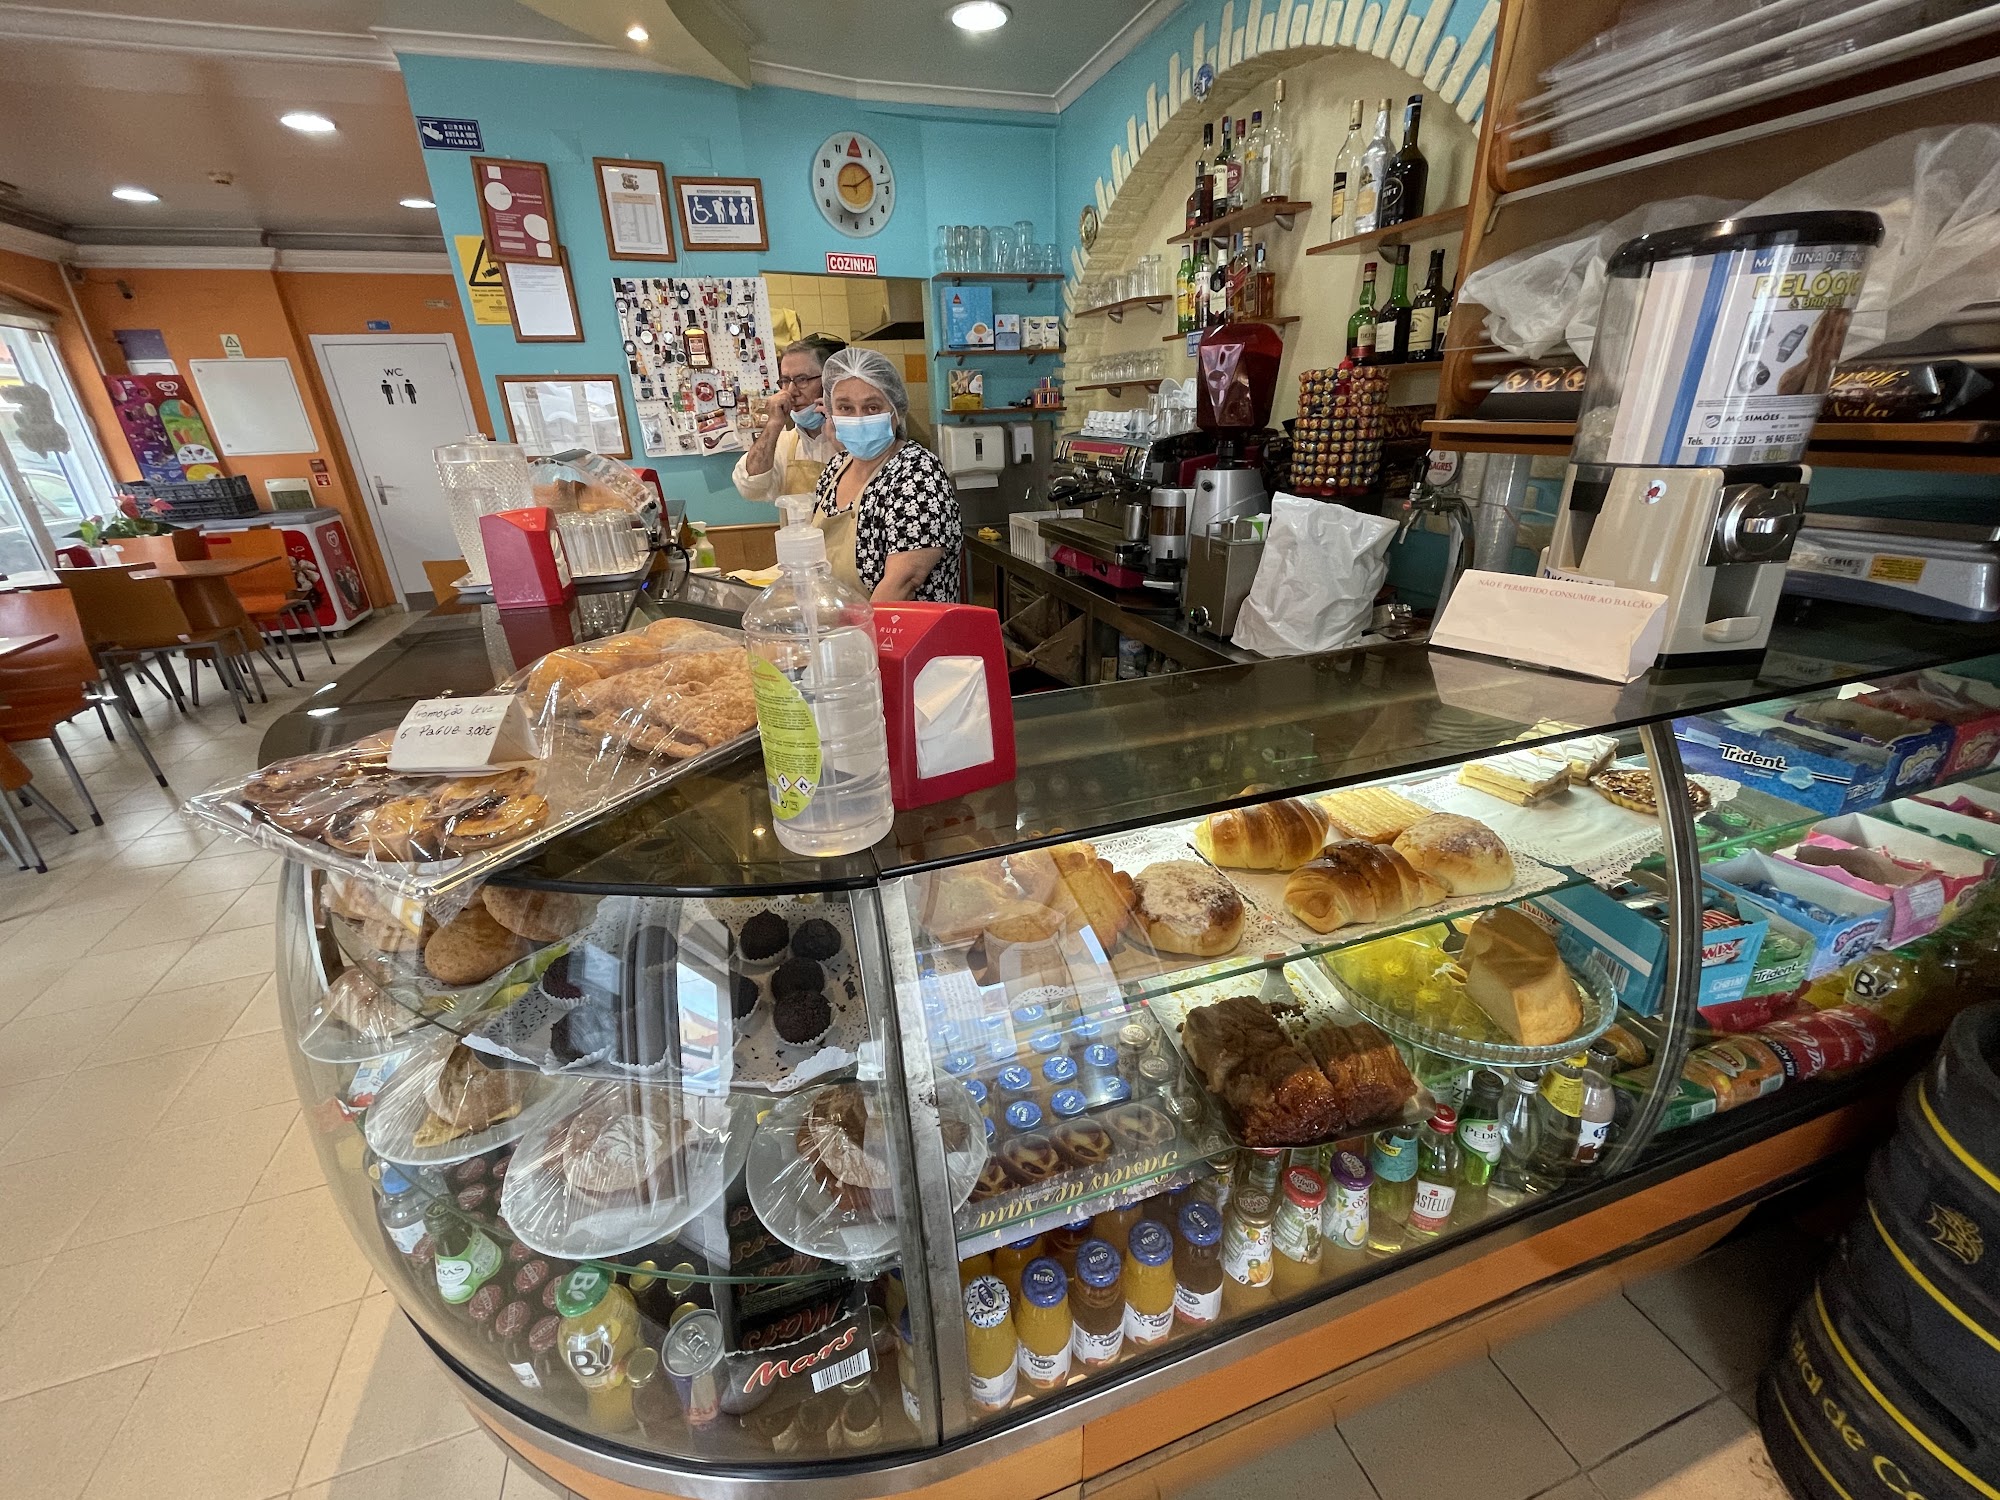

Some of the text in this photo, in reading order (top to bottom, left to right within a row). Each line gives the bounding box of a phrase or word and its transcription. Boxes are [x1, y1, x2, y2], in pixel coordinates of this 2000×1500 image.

[446, 138, 479, 146] FILMADO
[834, 144, 842, 154] 11
[868, 148, 872, 158] 1
[823, 158, 831, 169] 10
[879, 165, 885, 174] 2
[819, 178, 825, 187] 9
[885, 185, 890, 195] 3
[826, 199, 831, 208] 8
[880, 205, 885, 214] 4
[838, 214, 843, 223] 7
[869, 217, 874, 226] 5
[854, 220, 859, 230] 6
[1826, 251, 1841, 263] DE
[830, 256, 875, 272] COZINHA
[383, 368, 404, 377] WC
[1744, 412, 1780, 421] SIMÕES
[1479, 578, 1497, 588] NÃO
[1503, 583, 1549, 596] PERMITIDO
[1549, 589, 1597, 603] CONSUMIR
[1597, 597, 1613, 605] AO
[1613, 597, 1654, 610] BALCÃO
[880, 626, 904, 634] RUBY
[400, 726, 411, 740] 6
[1723, 745, 1786, 769] Trident
[1703, 940, 1735, 960] WIX
[1754, 963, 1798, 982] Trident
[1463, 1124, 1499, 1141] PEDR
[1191, 1210, 1209, 1229] Hero
[1140, 1231, 1160, 1245] Hero
[1088, 1251, 1108, 1264] Hero
[1033, 1273, 1054, 1283] Hero
[979, 1285, 994, 1307] Hero
[743, 1326, 858, 1393] Mars
[1822, 1396, 1866, 1451] de
